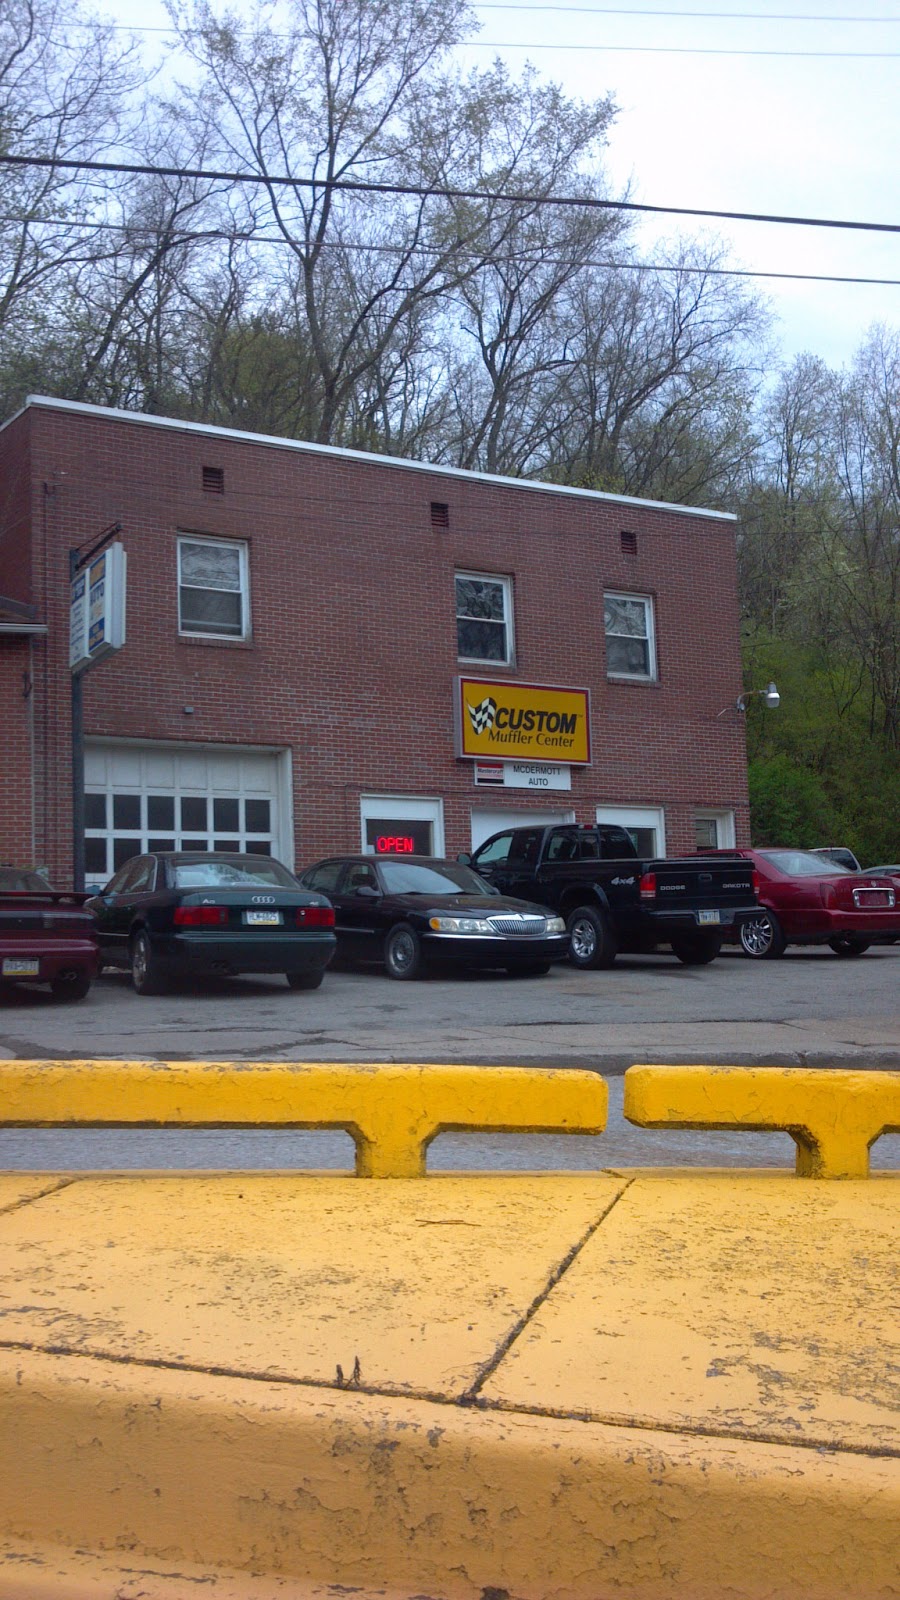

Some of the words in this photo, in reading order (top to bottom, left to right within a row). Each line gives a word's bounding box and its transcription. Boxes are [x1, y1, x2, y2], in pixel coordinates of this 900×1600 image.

[495, 707, 577, 734] CUSTOM
[488, 730, 533, 744] Muffler
[536, 733, 574, 747] Center
[513, 765, 561, 775] MCDERMOTT
[528, 778, 548, 786] AUTO
[377, 837, 413, 852] OPEN
